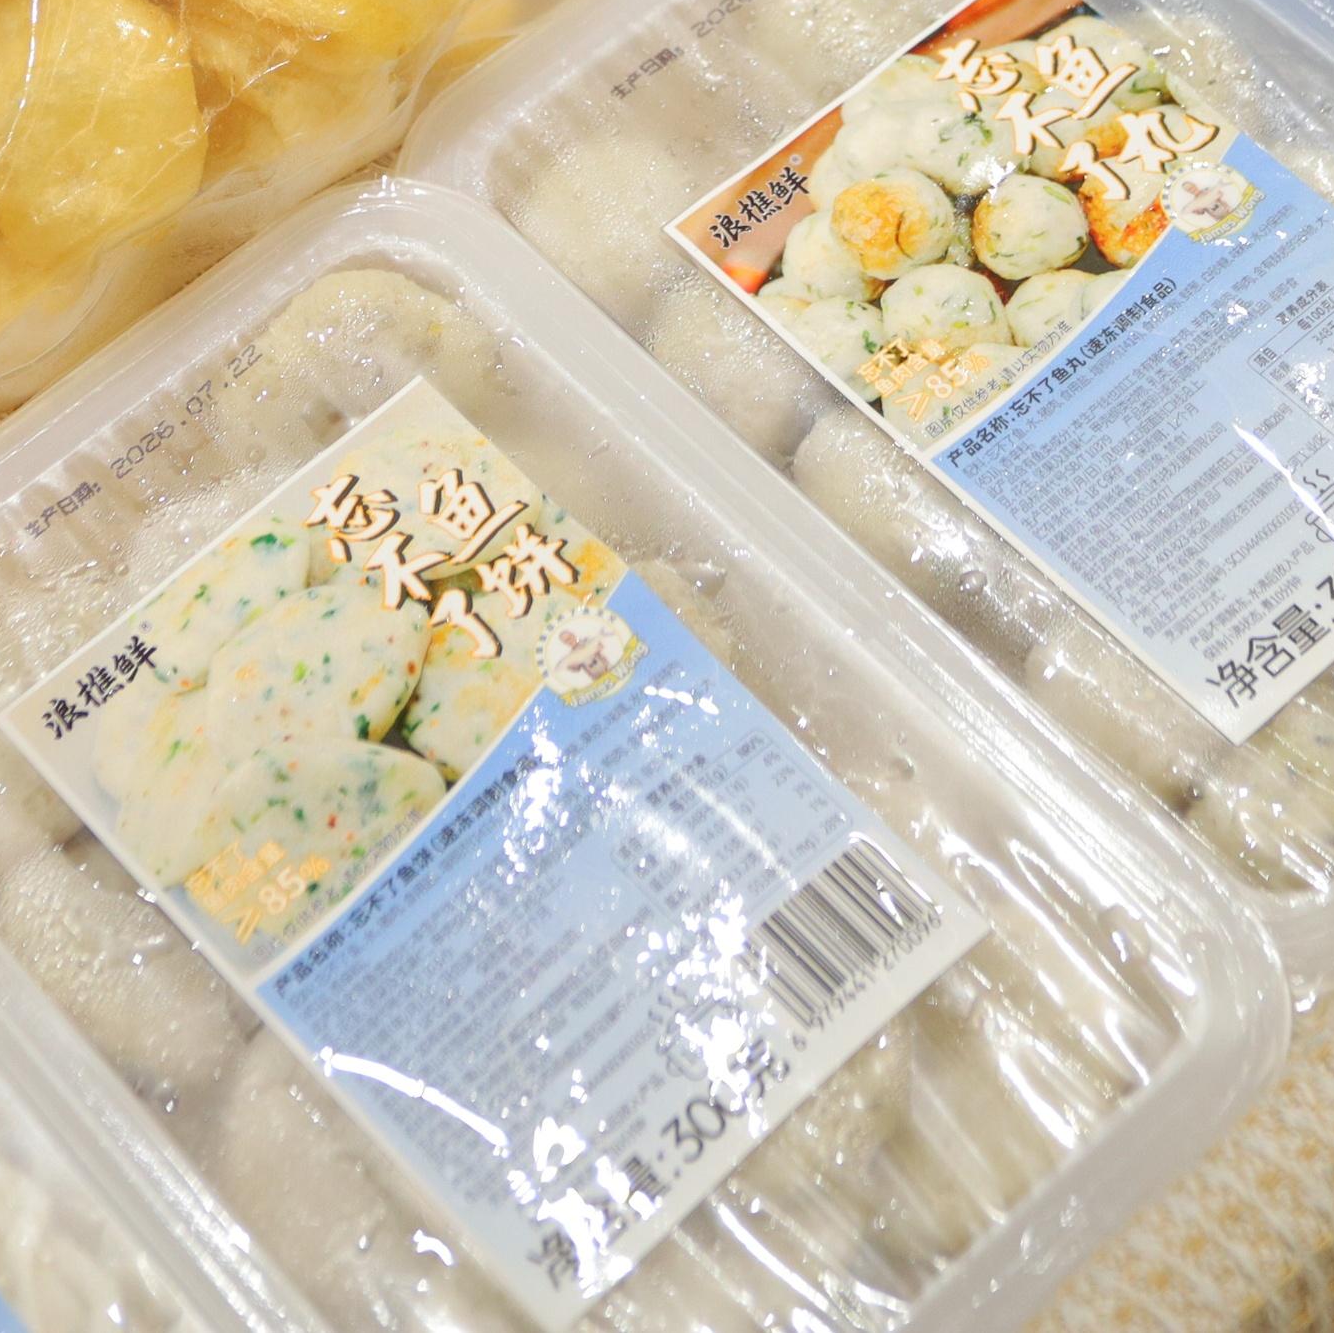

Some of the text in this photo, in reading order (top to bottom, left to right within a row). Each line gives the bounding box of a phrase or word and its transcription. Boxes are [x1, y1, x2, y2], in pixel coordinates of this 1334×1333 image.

[705, 160, 817, 253] 浪樵鲜
[1252, 346, 1278, 368] 项目
[34, 631, 165, 741] 浪樵鲜
